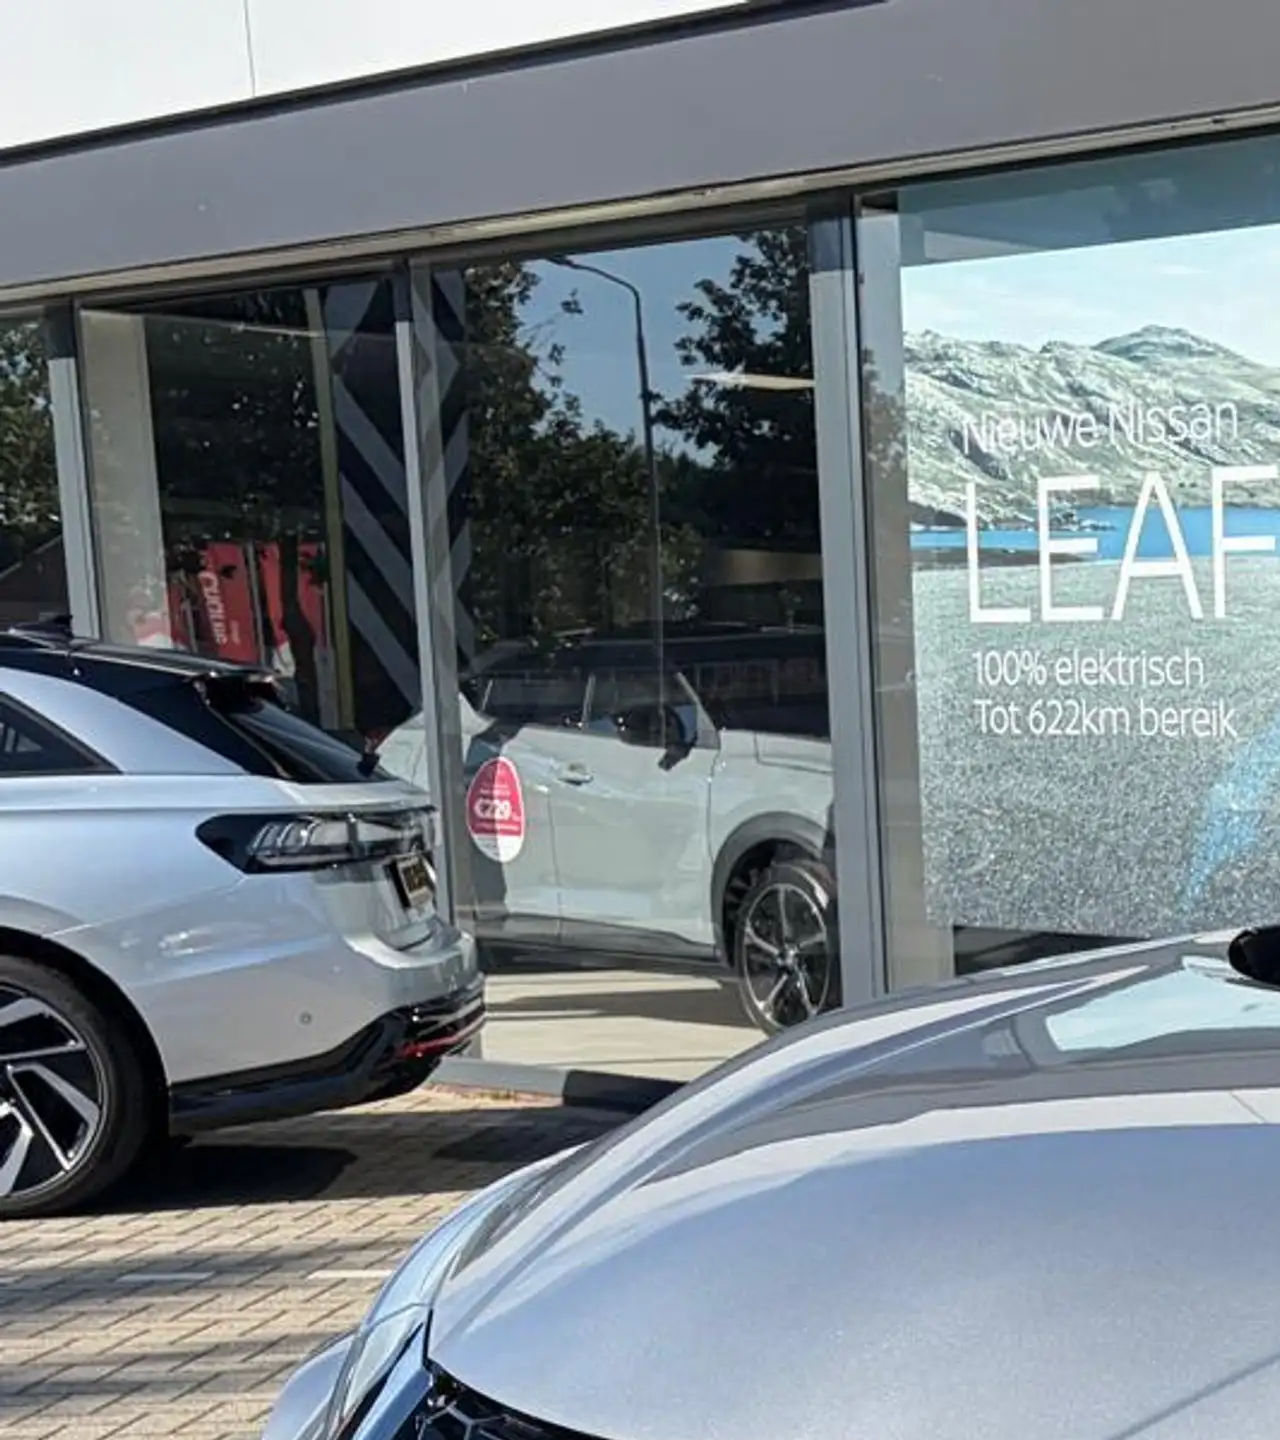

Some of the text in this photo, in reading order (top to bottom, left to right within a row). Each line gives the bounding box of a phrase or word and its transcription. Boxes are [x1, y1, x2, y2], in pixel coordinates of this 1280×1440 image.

[962, 401, 1238, 454] Nieuwe Nissan
[966, 465, 1279, 623] LEAF
[972, 647, 1204, 687] 100% elektrisch
[973, 697, 1238, 737] Tot 622km bereik
